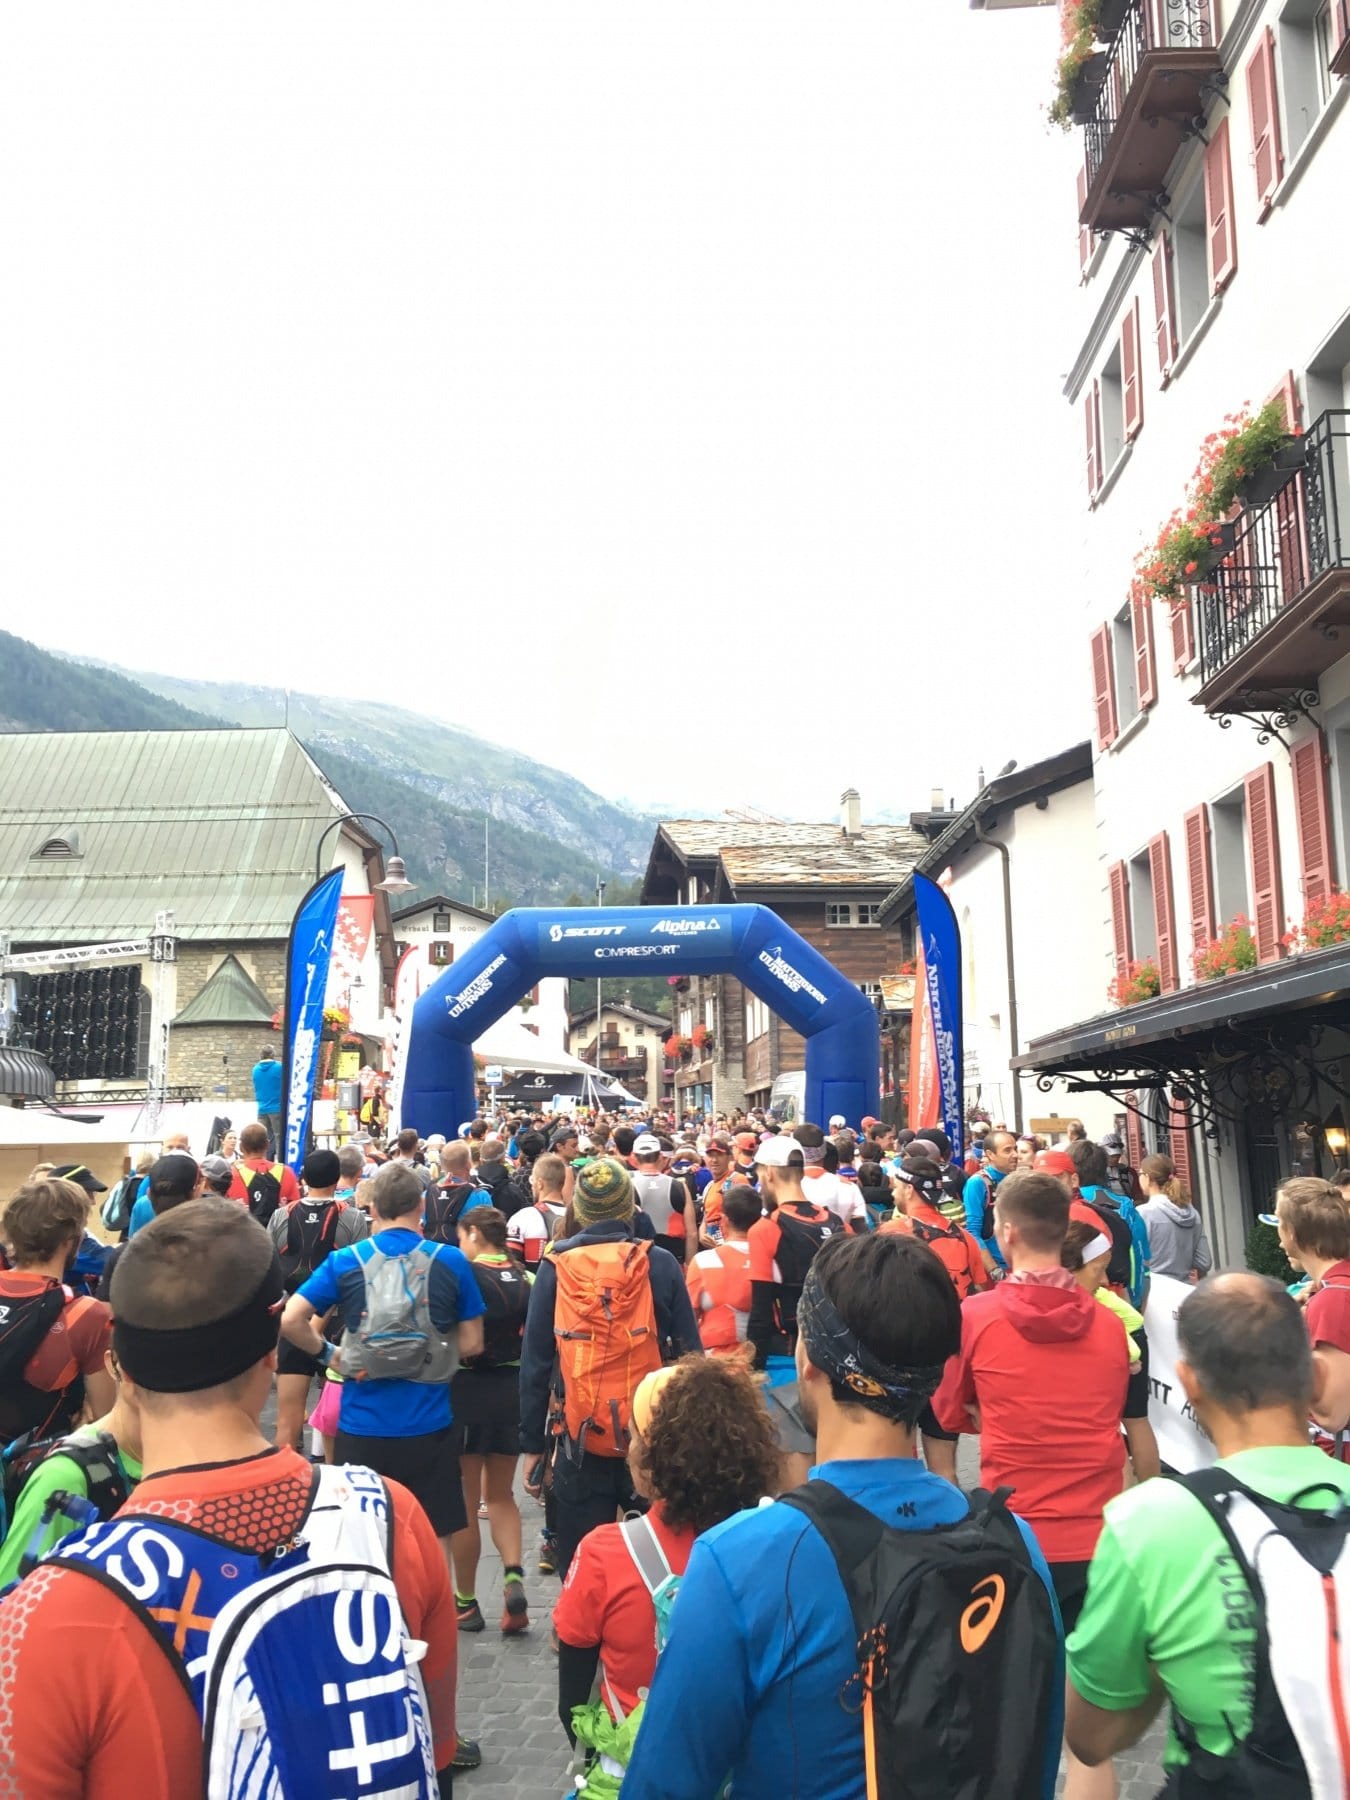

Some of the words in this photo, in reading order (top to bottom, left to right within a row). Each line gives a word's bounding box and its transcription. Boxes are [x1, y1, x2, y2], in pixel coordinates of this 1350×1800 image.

[563, 925, 627, 937] SCOTT
[650, 919, 706, 934] Alpina
[457, 953, 507, 1003] MATTERHORN
[759, 950, 802, 992] ULTRAKS
[774, 958, 828, 1004] MATTERHORN
[448, 979, 493, 1017] ULTRAKS
